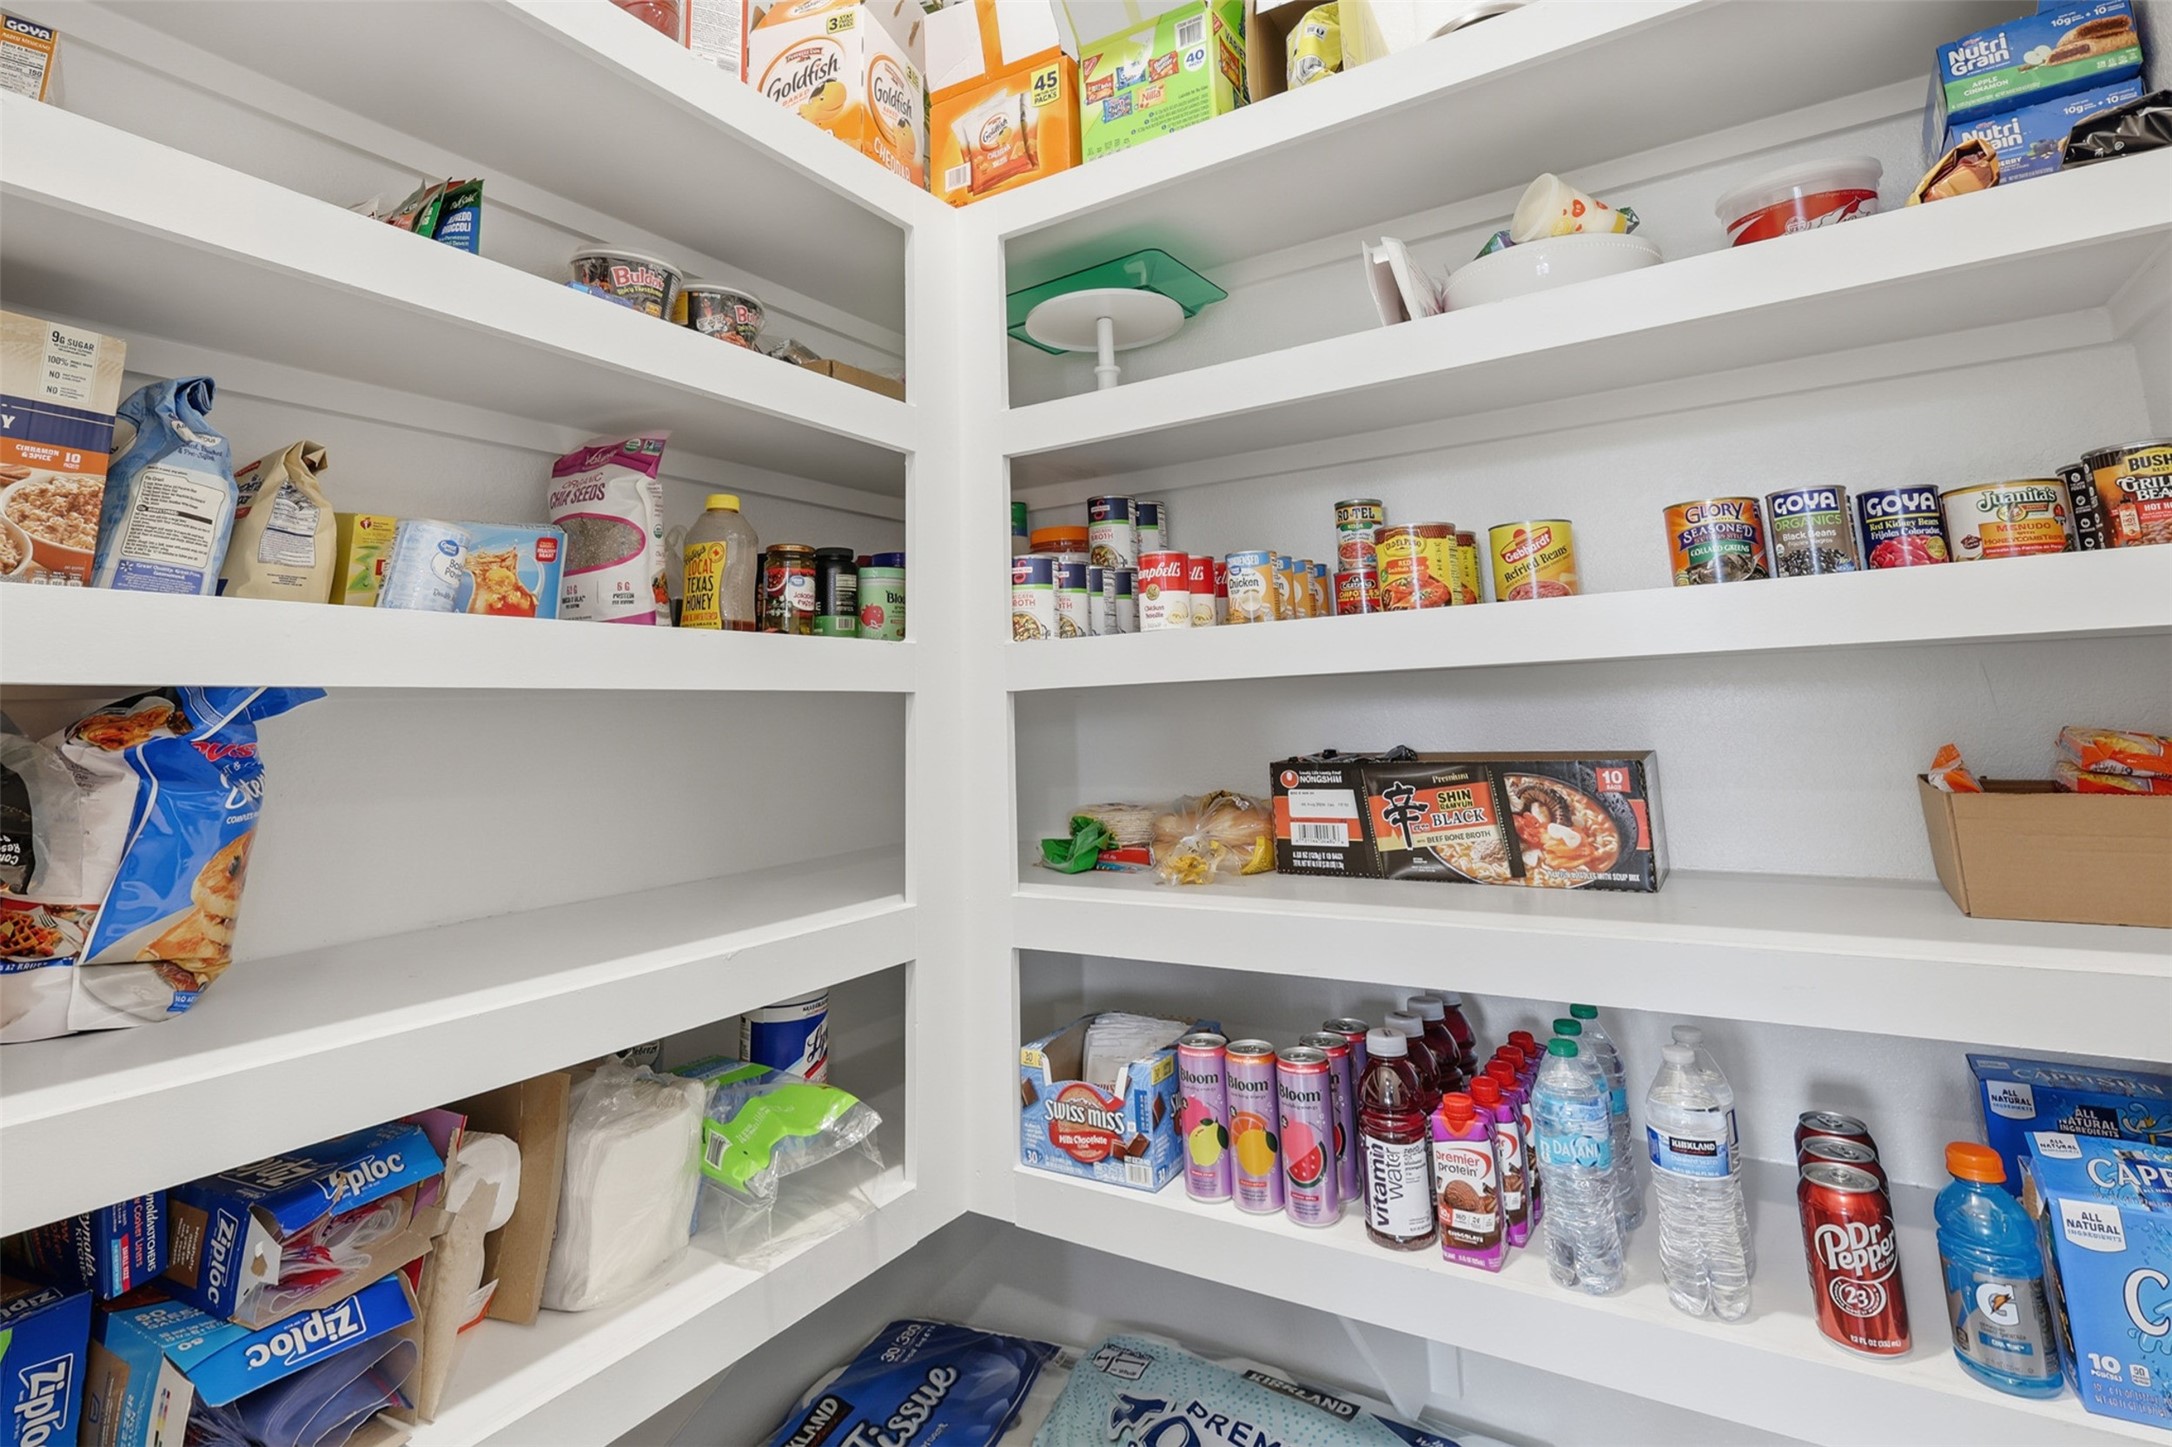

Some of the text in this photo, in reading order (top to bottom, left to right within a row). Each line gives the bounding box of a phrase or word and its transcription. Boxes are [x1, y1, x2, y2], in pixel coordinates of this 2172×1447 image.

[829, 18, 838, 31] 3
[2051, 7, 2107, 27] 10g 10
[6, 20, 51, 40] GOYA
[1186, 48, 1205, 63] 40
[1948, 32, 2008, 67] Nutri
[1951, 50, 2010, 76] Grain
[767, 52, 839, 102] Goldfish
[1034, 71, 1058, 91] 45
[1972, 76, 1998, 88] APPLE
[1963, 80, 2009, 97] CINNAMON
[874, 77, 912, 120] Goldfish
[1034, 92, 1057, 104] PACKS
[2063, 95, 2119, 115] 10g 10
[1961, 118, 2022, 144] Nutri
[52, 331, 95, 351] 9G SUGAR
[48, 355, 69, 367] 100%
[49, 371, 60, 379] NO
[46, 386, 58, 394] NO
[16, 443, 60, 457] CINNAMON
[29, 451, 52, 462] SPICE
[65, 451, 82, 463] 10
[562, 472, 604, 490] ORGANIC
[550, 483, 605, 509] CHIA SEEDS
[1774, 491, 1837, 514] GOYA
[1977, 487, 2057, 512] Juanita's
[2137, 487, 2172, 501] BEA
[1867, 492, 1936, 516] GOYA
[2144, 503, 2161, 511] HOT
[1686, 503, 1744, 524] GLORY
[1775, 514, 1842, 532] ORGANICS
[1869, 518, 1939, 531] Red Kidney Beans
[1996, 522, 2051, 532] MENUDO
[1091, 531, 1114, 541] BROTH
[1683, 523, 1753, 543] SEASONED
[1783, 529, 1837, 542] Black Beans
[1870, 530, 1899, 540] Frijoles
[1504, 534, 1550, 563] Gebhardt
[1690, 543, 1750, 557] COLLARD GREENS
[689, 558, 714, 576] LOCAL
[1138, 561, 1181, 581] ampbell's
[1504, 556, 1539, 583] Refried
[1540, 545, 1567, 564] Beans
[687, 575, 714, 593] TEXAS
[1229, 578, 1259, 589] Chicken
[686, 593, 714, 611] HONEY
[1012, 599, 1036, 607] ROTH
[1299, 775, 1342, 784] NONGSHIM
[1432, 773, 1469, 784] Premium
[1602, 770, 1623, 784] 10
[1437, 789, 1472, 803] SHIN
[1440, 800, 1473, 810] RAMYUN
[1383, 782, 1430, 851] 辛
[1431, 808, 1487, 828] BLACK
[1427, 830, 1491, 844] BEEF BONE BROTH
[1180, 1066, 1219, 1085] Bloom
[1227, 1072, 1269, 1092] Bloom
[1279, 1081, 1321, 1102] Bloom
[2002, 1089, 2018, 1097] ALL
[1991, 1094, 2032, 1107] NATURAL
[1044, 1100, 1125, 1136] SWISS MISS
[2074, 1108, 2098, 1120] ALL
[2059, 1118, 2118, 1132] NATURAL
[2060, 1124, 2120, 1138] INGREDIENTS
[1059, 1134, 1108, 1145] Milk Chocolate
[1671, 1138, 1716, 1151] KIRKLAND
[2040, 1142, 2078, 1151] NATURAL
[1026, 1150, 1038, 1162] 30
[1552, 1139, 1599, 1160] DASANI
[1436, 1150, 1481, 1167] premier
[1386, 1146, 1404, 1200] water
[1438, 1162, 1478, 1178] protein
[1370, 1142, 1390, 1227] vitamin
[133, 1204, 142, 1238] Cooker
[2081, 1211, 2102, 1223] ALL
[2066, 1219, 2121, 1235] NATURAL
[1447, 1229, 1484, 1243] CHOCOLATE
[1845, 1222, 1881, 1250] Dr
[2067, 1229, 2122, 1243] INGREDIENTS
[1814, 1223, 1895, 1277] Pepper
[208, 1216, 235, 1305] Ziploc
[1844, 1286, 1869, 1309] 23
[1976, 1282, 2020, 1326] G
[246, 1305, 358, 1368] Ziploc
[2088, 1353, 2122, 1375] 10
[2091, 1370, 2123, 1383] POUCHES
[1247, 1372, 1356, 1418] KIRKLAND
[840, 1366, 957, 1447] Tissue
